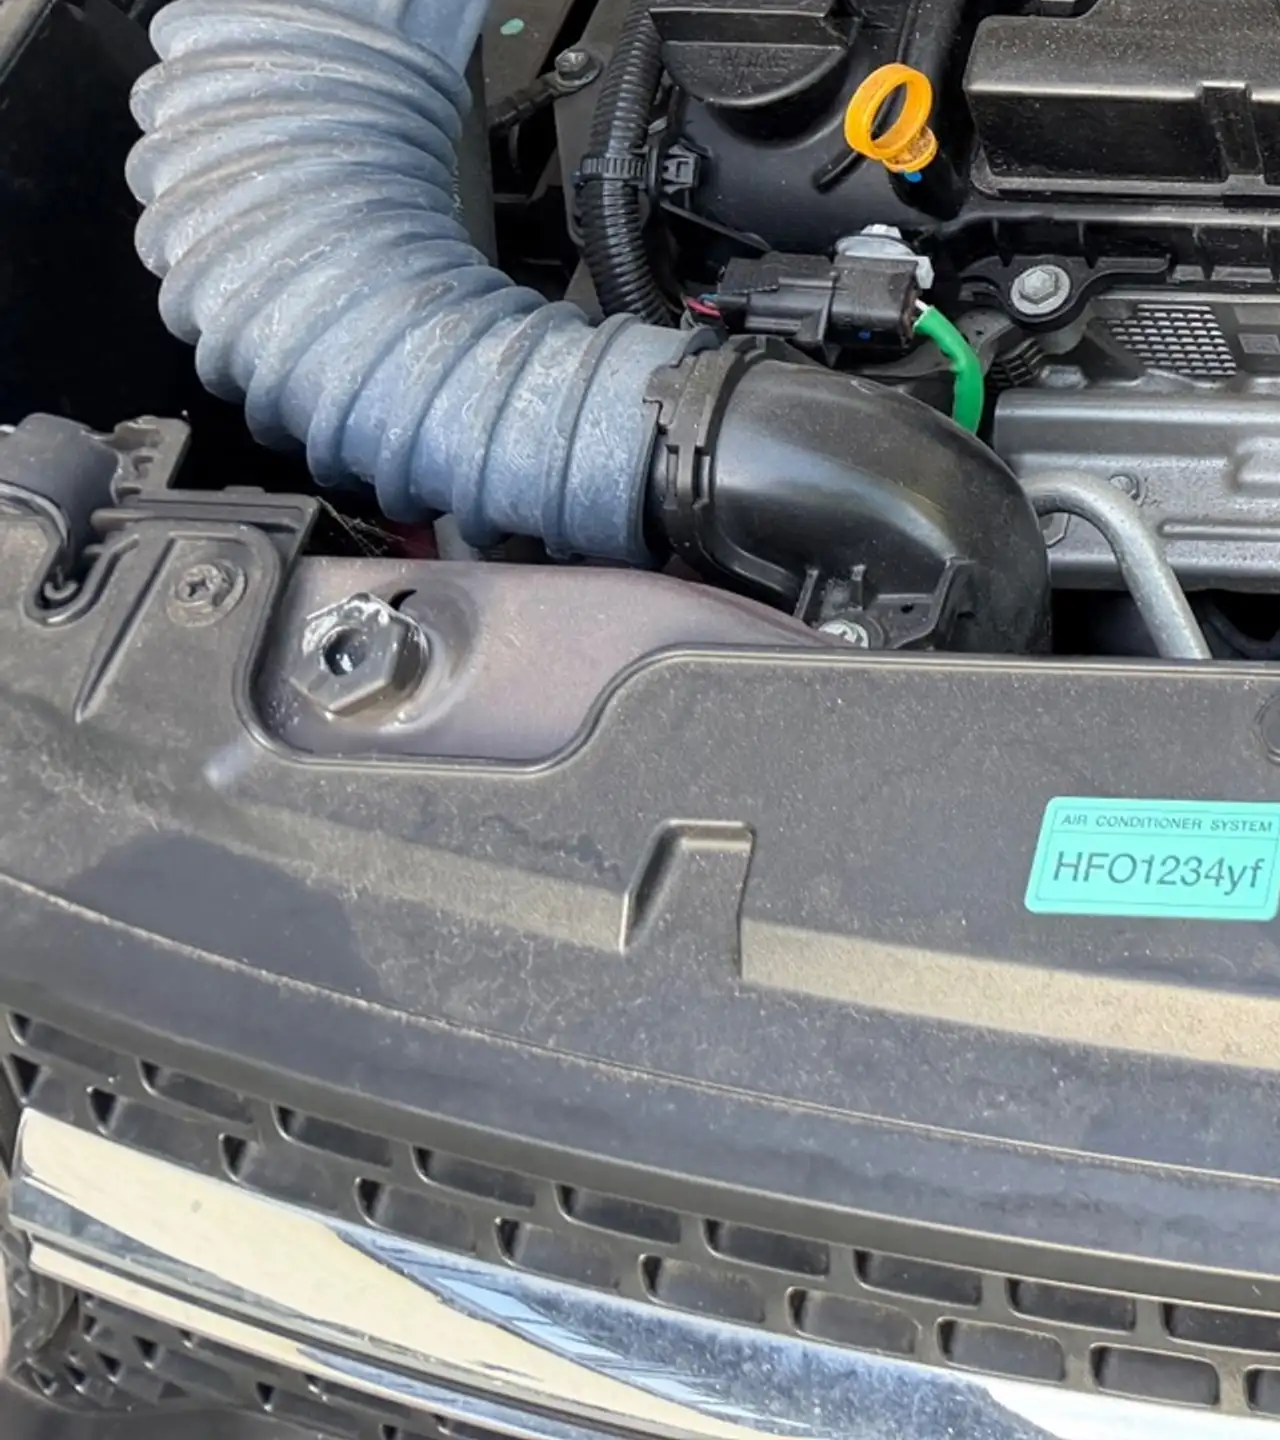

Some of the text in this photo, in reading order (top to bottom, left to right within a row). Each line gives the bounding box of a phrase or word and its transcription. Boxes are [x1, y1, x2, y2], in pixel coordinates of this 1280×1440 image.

[1061, 814, 1273, 833] AIR CONDITIONER SYSTEM
[1052, 850, 1266, 896] HFO1234yf
